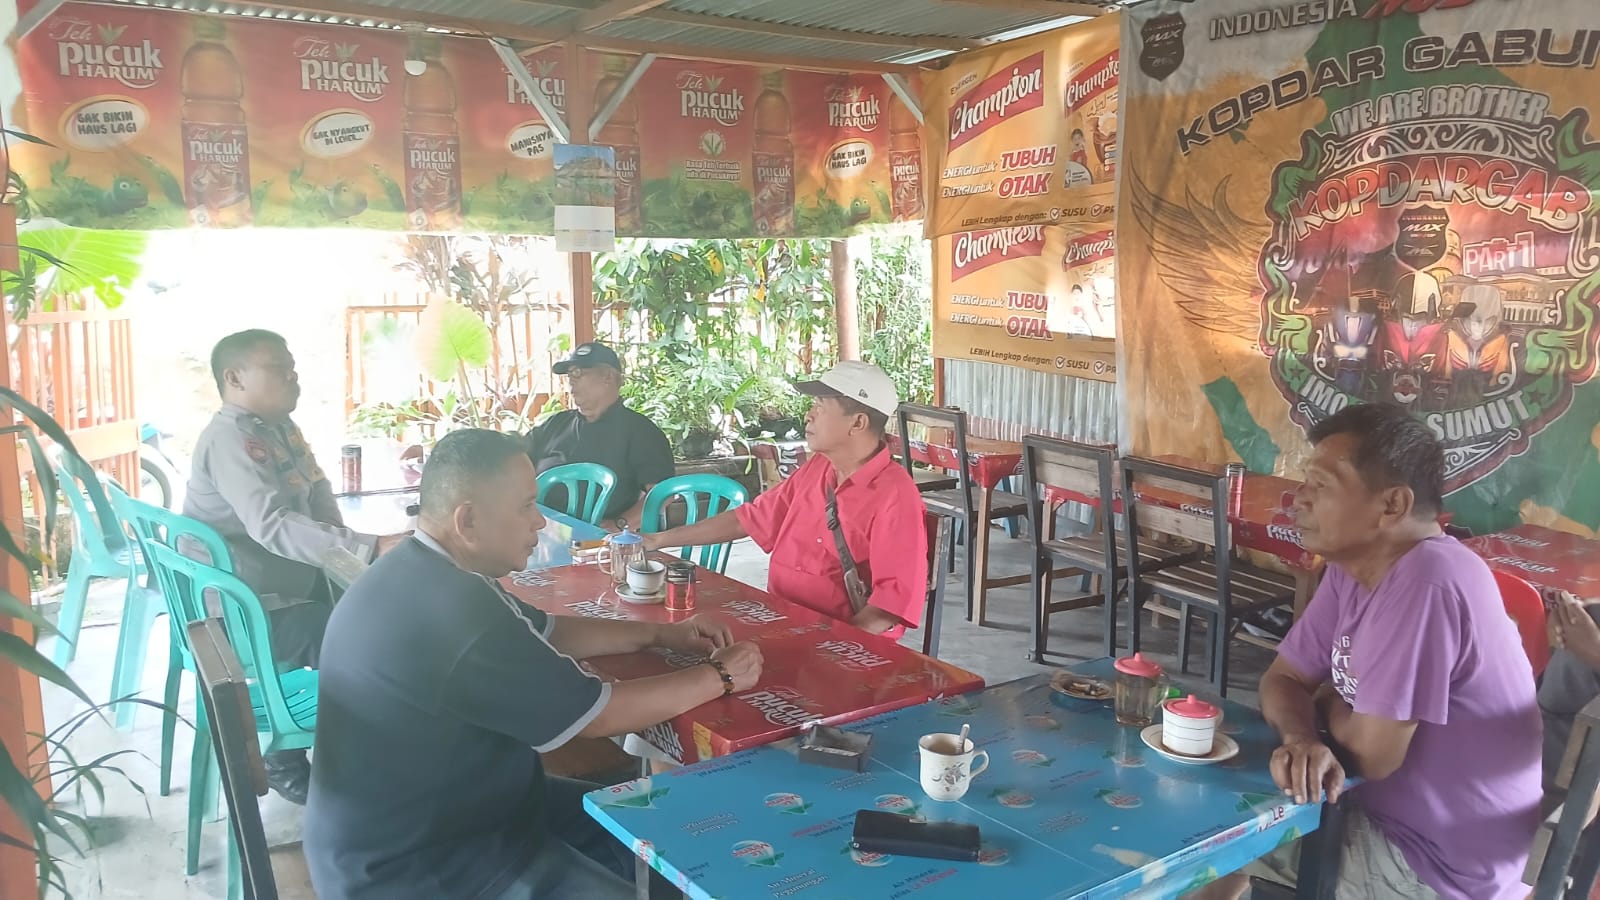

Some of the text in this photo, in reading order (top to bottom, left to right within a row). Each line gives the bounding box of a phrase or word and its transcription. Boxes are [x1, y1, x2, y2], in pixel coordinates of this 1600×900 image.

[1209, 0, 1357, 40] INDONESIA
[58, 40, 164, 76] pucuk
[78, 65, 158, 88] HARUM
[300, 57, 390, 90] pucuk
[319, 81, 385, 102] HARUM
[681, 89, 744, 117] pucuk
[1176, 46, 1386, 157] KOPDAR
[829, 94, 881, 126] pucuk
[951, 68, 1042, 140] Champion
[1333, 86, 1550, 138] WE ARE BROTHER
[78, 111, 134, 123] GAK BIKIN
[692, 107, 741, 127] HARUM
[834, 115, 879, 131] HARUM
[78, 123, 137, 136] HAUS LAGI
[510, 129, 554, 152] MANISNYA
[527, 143, 544, 156] PAS
[1001, 145, 1056, 172] TUBUH
[616, 157, 637, 172] cuk
[942, 160, 998, 179] ENERGI untuk
[942, 185, 970, 198] ENERGI
[998, 172, 1053, 199] OTAK
[1290, 155, 1592, 241] KOPDARGAB
[980, 213, 1013, 225] Lengkap
[1014, 211, 1048, 223] dengan:
[1061, 207, 1087, 218] SUSU
[1402, 223, 1445, 232] MAX
[1466, 243, 1519, 273] PART
[951, 295, 1004, 309] ENERGI untuk
[949, 313, 1003, 329] ENERGI untuk
[969, 347, 990, 358] LEBIH
[991, 350, 1021, 361] Lengkap
[1023, 354, 1052, 366] dengan:
[1066, 359, 1090, 370] SUSU
[1300, 374, 1348, 416] IMO
[1427, 390, 1531, 442] SUMUT
[1266, 524, 1303, 541] pucu
